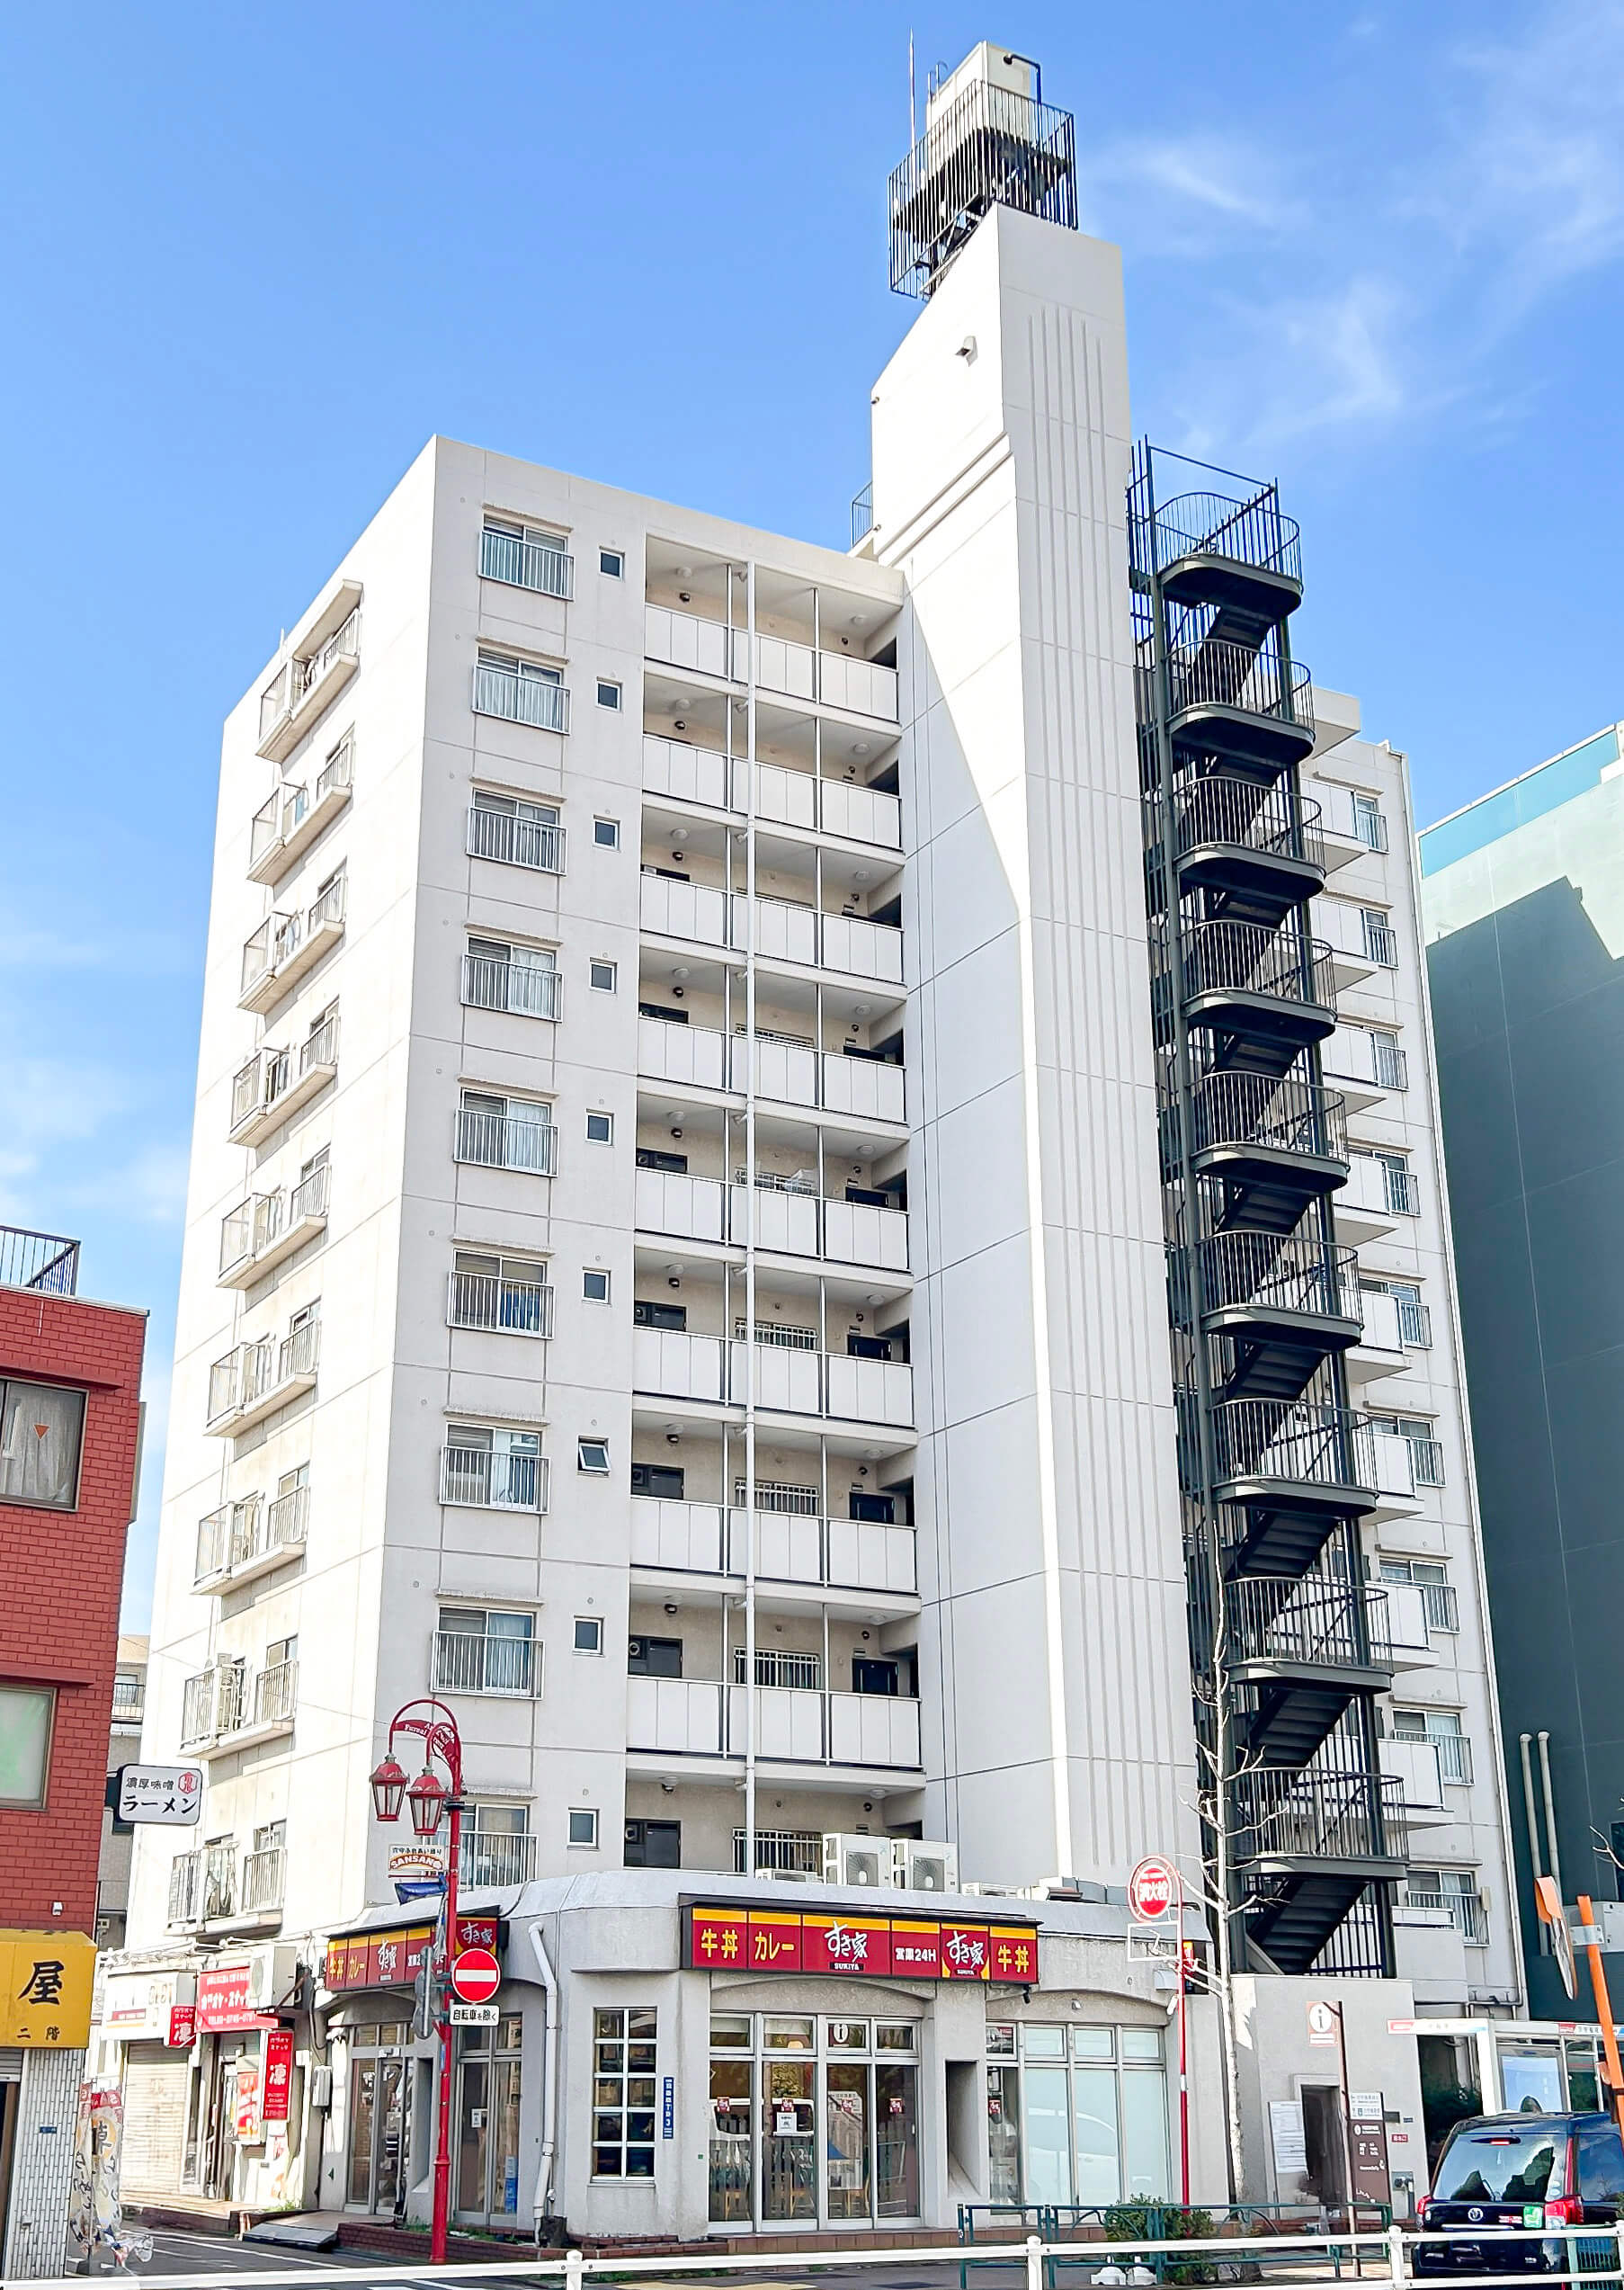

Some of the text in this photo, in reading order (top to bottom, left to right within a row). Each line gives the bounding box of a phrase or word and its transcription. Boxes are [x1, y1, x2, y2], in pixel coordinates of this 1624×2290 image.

[126, 1776, 174, 1790] 濃厚味噌
[122, 1794, 198, 1814] ラーメン
[460, 1921, 494, 1946] すき家
[700, 1928, 738, 1959] 牛丼
[754, 1930, 795, 1961] カレー
[824, 1920, 869, 1963] すき家
[378, 1937, 397, 1973] すき家
[895, 1946, 937, 1963] 営業24H
[946, 1930, 986, 1970] すき家
[997, 1944, 1030, 1974] 牛丼
[348, 1955, 365, 1980] カレー
[834, 1963, 860, 1971] SUKIYA
[17, 1960, 65, 2005] 屋
[452, 2008, 496, 2021] 自転車を除く
[16, 2026, 60, 2041] 二階
